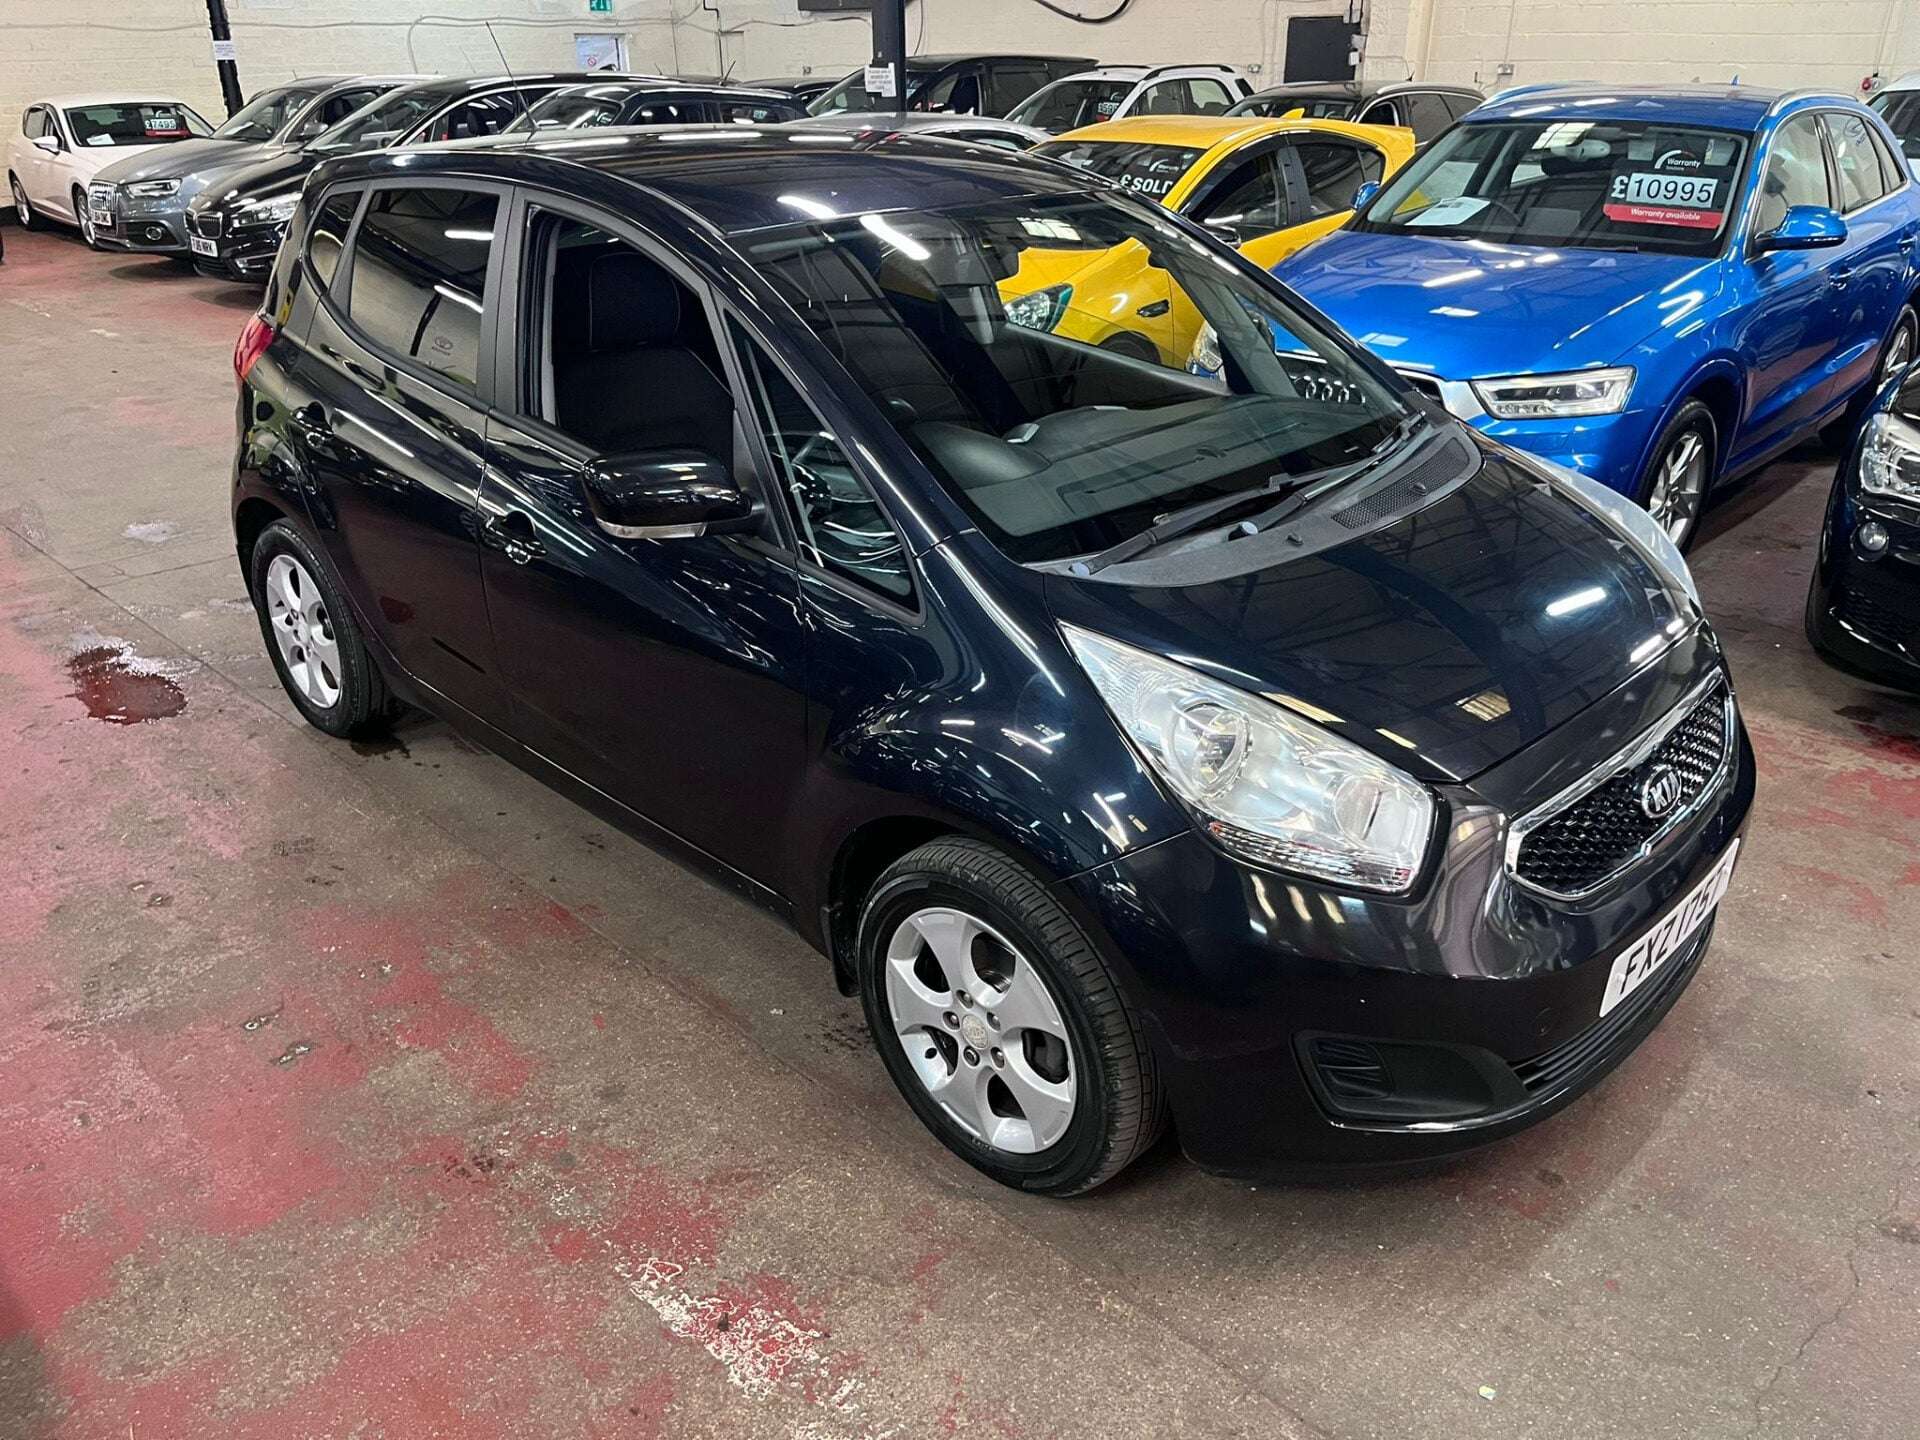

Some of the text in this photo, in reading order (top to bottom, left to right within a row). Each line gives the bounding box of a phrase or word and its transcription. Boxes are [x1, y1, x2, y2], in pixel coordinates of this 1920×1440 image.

[1667, 158, 1700, 168] Warranty
[1632, 208, 1700, 221] Warranty available
[1650, 771, 1680, 811] KIA
